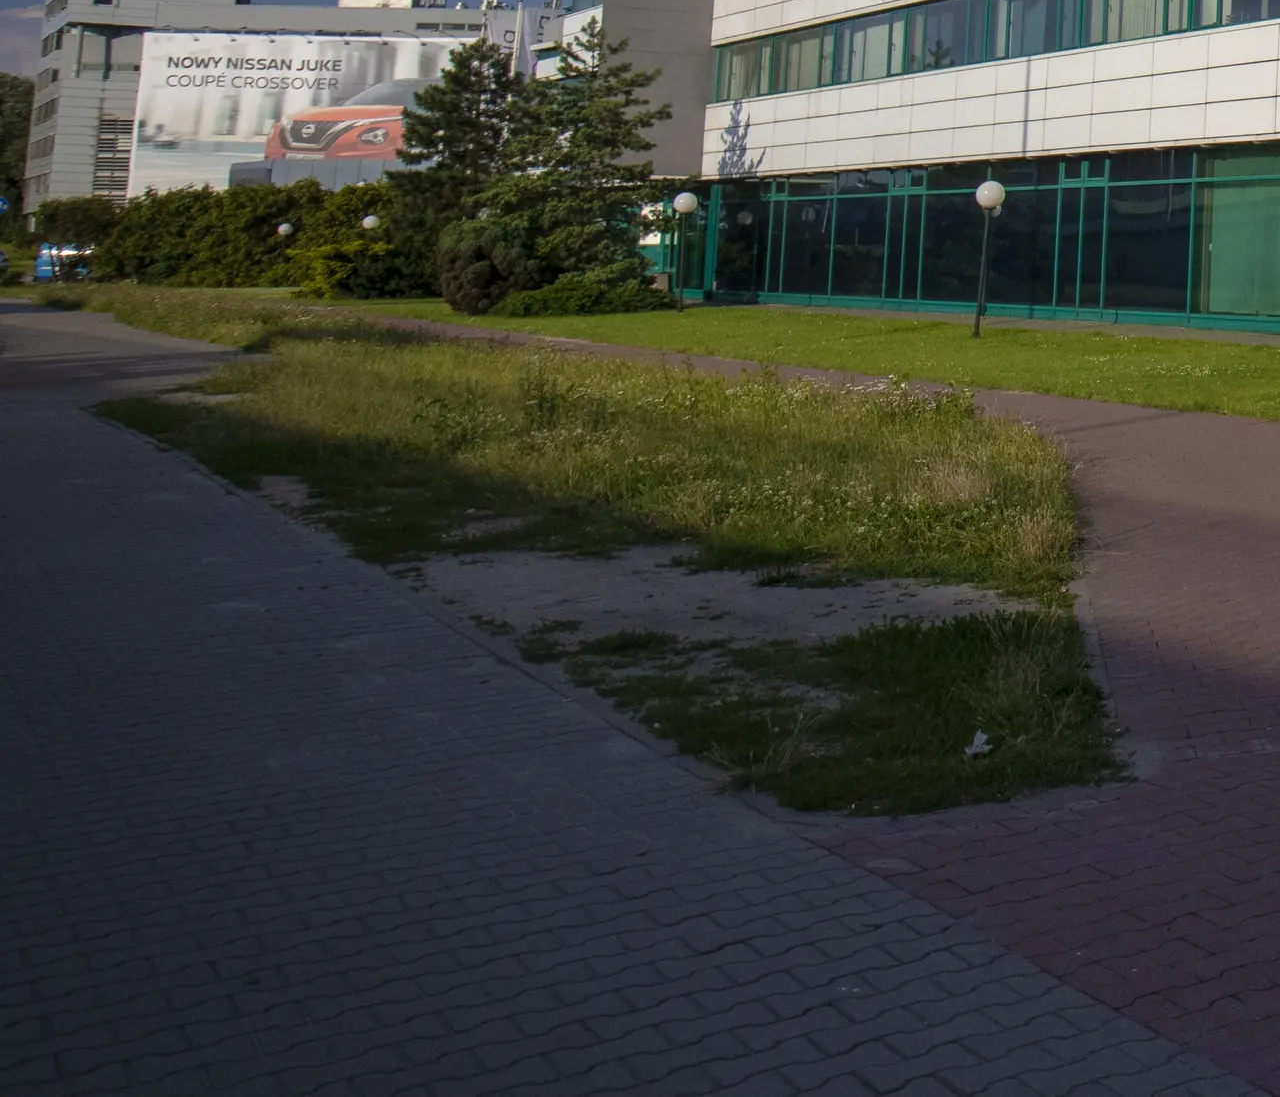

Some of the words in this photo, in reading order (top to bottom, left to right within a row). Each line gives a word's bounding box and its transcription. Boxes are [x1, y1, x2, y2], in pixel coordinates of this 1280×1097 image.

[167, 57, 223, 69] NOWY
[226, 57, 292, 71] NISSAN
[296, 59, 342, 72] JUKE
[166, 72, 226, 88] COUPÉ
[231, 75, 339, 90] CROSSOVER
